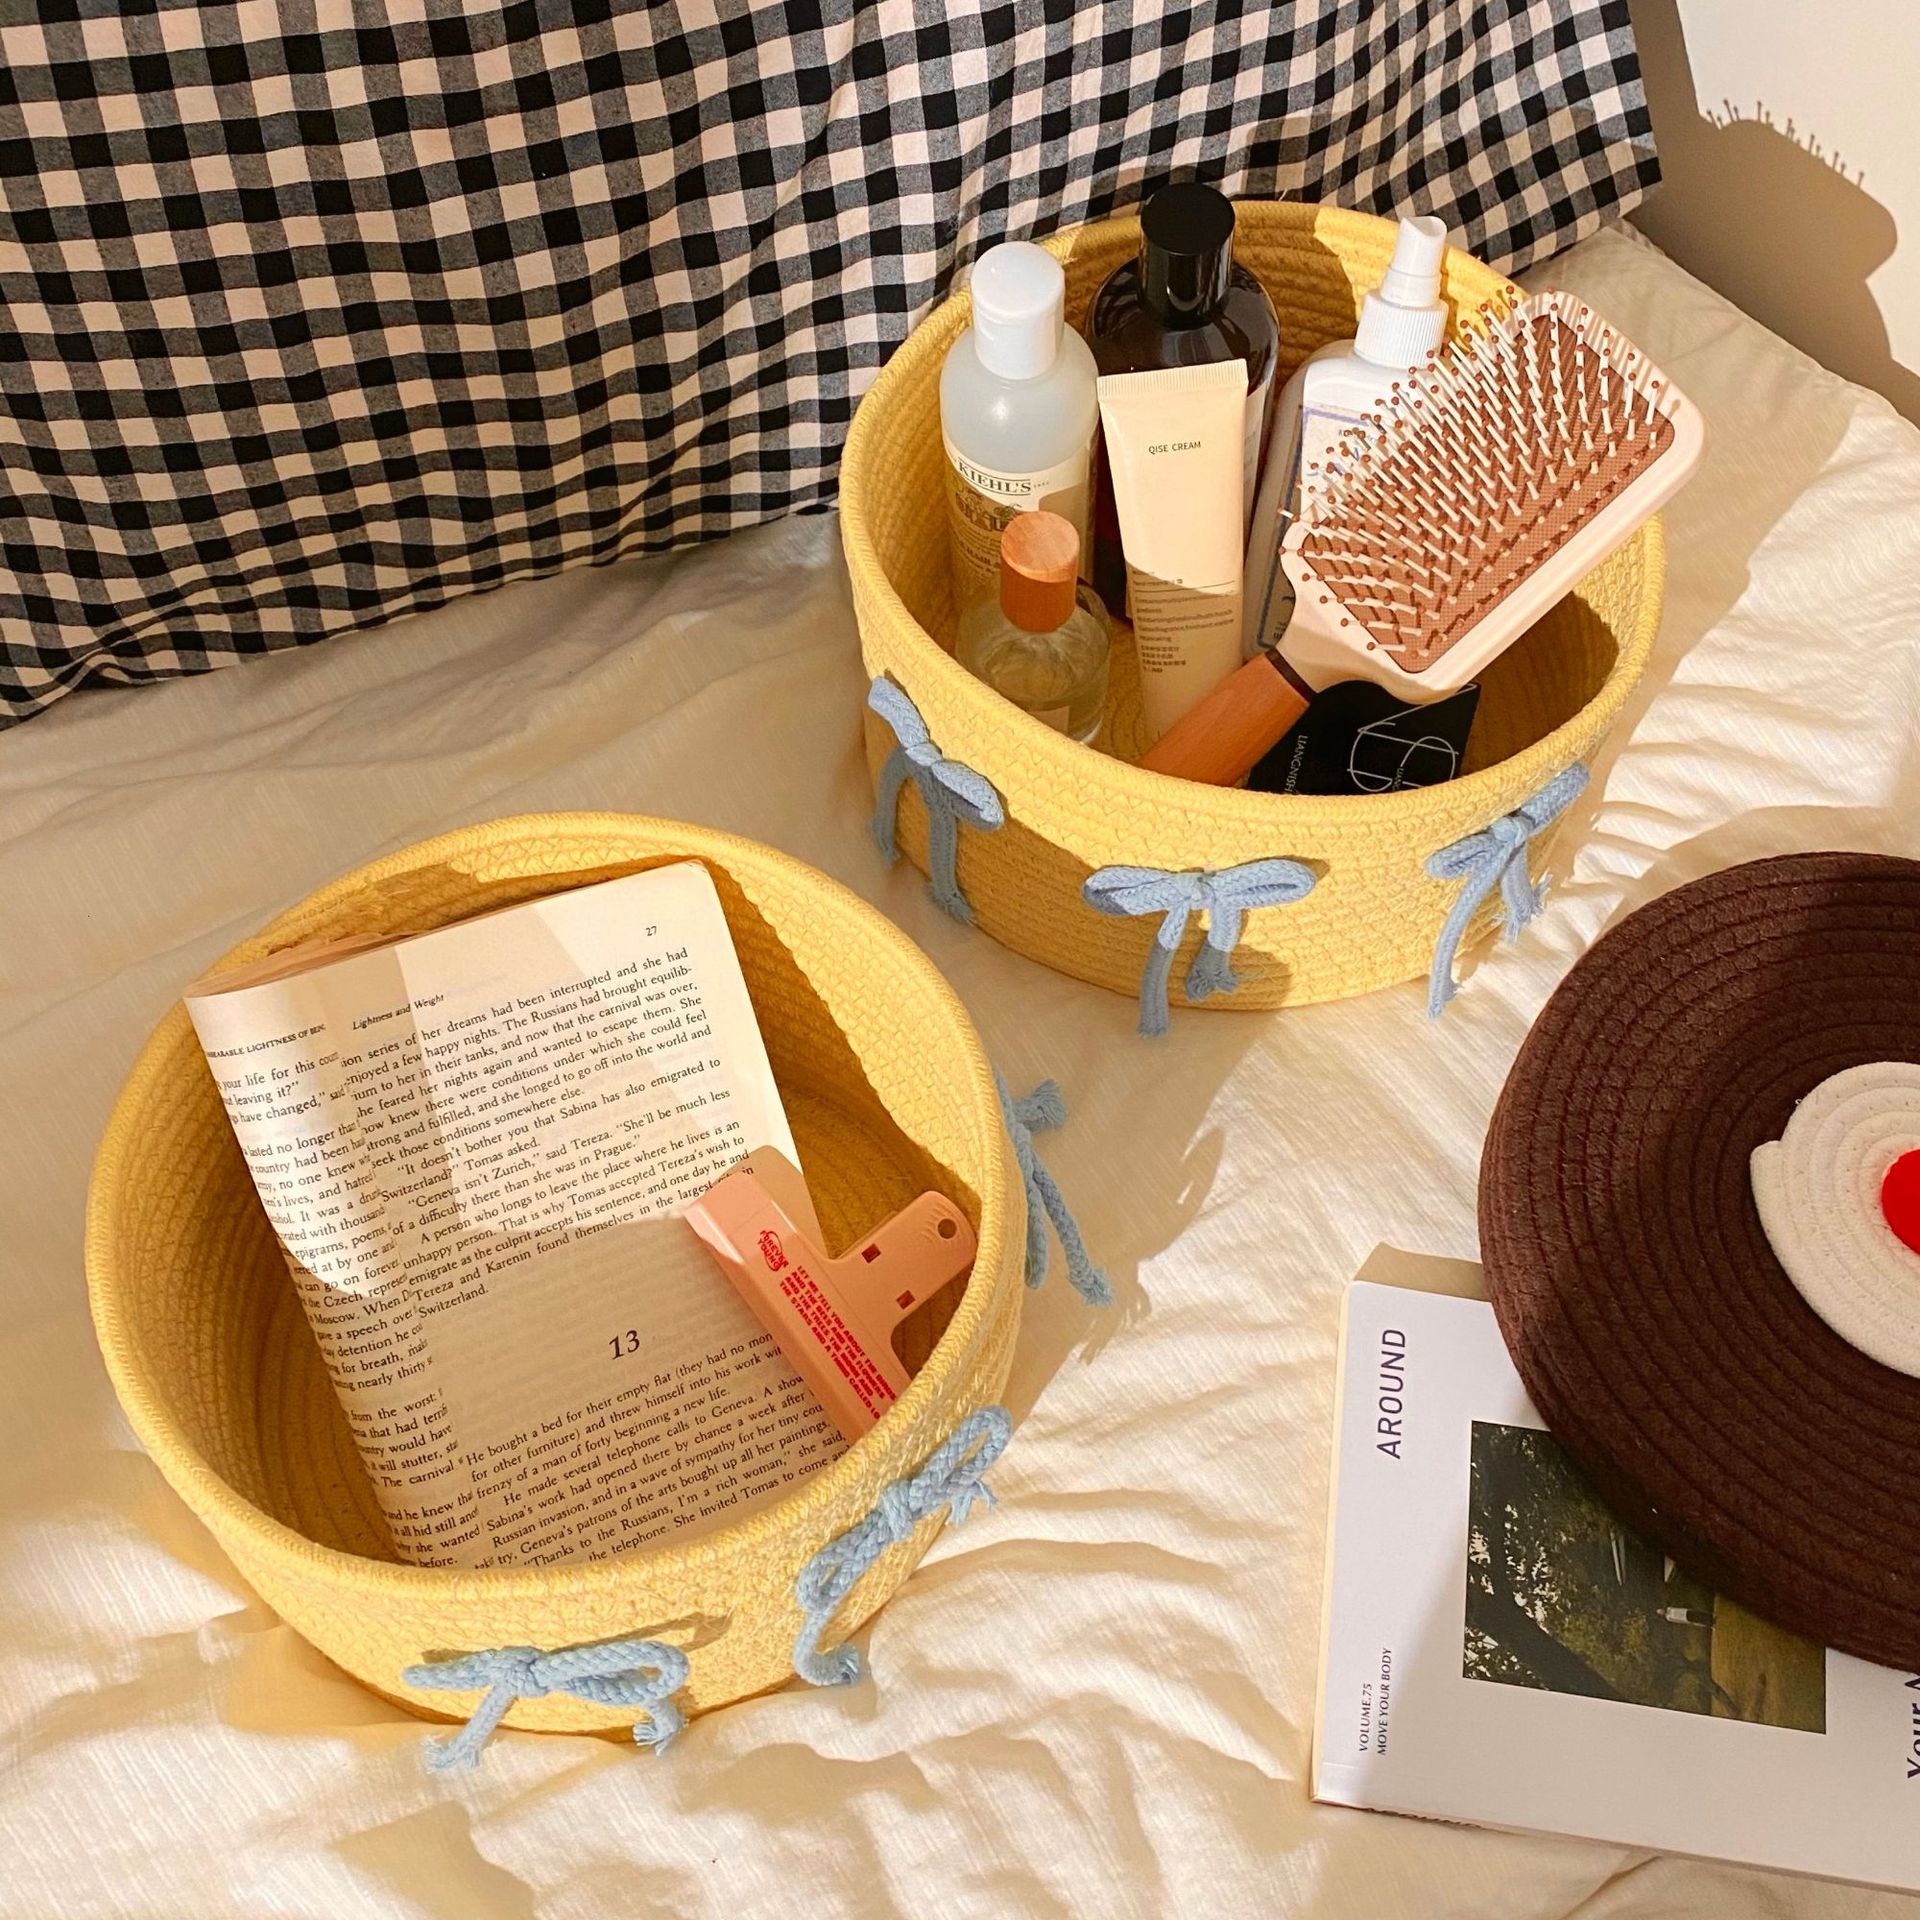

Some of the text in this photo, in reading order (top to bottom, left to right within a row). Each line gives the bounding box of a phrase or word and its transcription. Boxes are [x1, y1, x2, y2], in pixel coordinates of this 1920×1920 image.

[958, 461, 1032, 493] KIEHL'S
[1148, 441, 1201, 455] QISE CREAM
[645, 925, 657, 936] 27
[352, 994, 444, 1030] Lightness and Weight
[367, 1042, 400, 1059] series
[404, 1031, 417, 1046] of
[420, 1028, 440, 1040] her
[446, 1013, 487, 1032] dreams
[490, 1001, 513, 1018] had
[515, 994, 545, 1009] been
[549, 969, 611, 998] interrupted
[616, 961, 638, 977] and
[642, 957, 661, 970] she
[665, 946, 688, 962] had
[380, 1081, 393, 1091] to
[395, 1073, 415, 1086] her
[419, 1068, 432, 1078] in
[434, 1057, 461, 1073] their
[464, 1045, 498, 1062] tanks,
[500, 1034, 522, 1051] and
[524, 1028, 548, 1042] now
[552, 1018, 574, 1033] that
[576, 1012, 595, 1025] the
[598, 994, 641, 1018] carnival
[644, 991, 666, 1002] was
[668, 982, 697, 996] over,
[391, 1060, 399, 1069] a
[401, 1053, 422, 1066] few
[423, 1040, 459, 1058] happy
[462, 1028, 500, 1045] nights.
[501, 1017, 527, 1031] The
[529, 1001, 578, 1023] Russians
[578, 989, 601, 1006] had
[601, 977, 647, 999] brought
[650, 964, 692, 984] equilib-
[244, 1071, 265, 1086] life
[270, 1067, 289, 1081] for
[294, 1059, 315, 1074] this
[378, 1088, 415, 1110] feared
[417, 1083, 438, 1096] her
[443, 1070, 478, 1088] nights
[482, 1058, 512, 1075] again
[516, 1045, 538, 1063] and
[541, 1031, 582, 1053] wanted
[585, 1029, 598, 1039] to
[602, 1016, 638, 1034] escape
[642, 1006, 675, 1020] them.
[679, 996, 701, 1009] She
[232, 1092, 273, 1105] leaving
[238, 1111, 262, 1122] have
[276, 1130, 335, 1154] no longer
[463, 1133, 502, 1153] bother
[507, 1124, 529, 1141] you
[533, 1113, 555, 1128] that
[559, 1100, 597, 1119] Sabina
[600, 1092, 620, 1104] has
[624, 1083, 645, 1096] also
[650, 1060, 704, 1087] emigrated
[708, 1058, 720, 1068] to
[545, 1143, 567, 1160] said
[569, 1131, 613, 1150] Tereza.
[656, 1108, 671, 1120] be
[675, 1094, 707, 1114] much
[709, 1090, 730, 1102] less
[462, 1151, 504, 1171] Tomas
[506, 1135, 540, 1156] asked.
[412, 1280, 454, 1301] Tereza
[459, 1266, 481, 1284] and
[485, 1250, 531, 1274] Karenin
[536, 1231, 570, 1254] found
[574, 1211, 634, 1239] themselves
[638, 1205, 650, 1215] in
[655, 1196, 673, 1208] the
[417, 1282, 488, 1318] Switzerland.
[608, 1329, 640, 1360] 13
[778, 1280, 793, 1296] THE
[790, 1296, 814, 1325] STARS
[810, 1325, 827, 1344] AND
[847, 1377, 873, 1408] CALLED
[784, 1275, 801, 1294] AND
[798, 1294, 812, 1310] THE
[827, 1336, 842, 1352] THE
[857, 1377, 873, 1396] AND
[791, 1270, 807, 1289] AND
[804, 1289, 818, 1304] THE
[830, 1325, 846, 1344] AND
[843, 1344, 857, 1360] THE
[807, 1280, 819, 1293] ME
[829, 1311, 846, 1329] YOU
[842, 1329, 865, 1357] ABOUT
[863, 1357, 877, 1373] THE
[465, 1451, 484, 1466] He
[486, 1432, 528, 1456] bought
[531, 1429, 538, 1438] a
[540, 1415, 563, 1433] bed
[565, 1410, 582, 1423] for
[585, 1397, 611, 1415] their
[615, 1382, 650, 1402] empty
[653, 1372, 671, 1387] flat
[675, 1360, 702, 1378] (they
[705, 1347, 727, 1365] had
[729, 1344, 744, 1355] no
[470, 1469, 487, 1482] for
[492, 1454, 521, 1473] other
[526, 1427, 580, 1459] furniture)
[584, 1415, 606, 1434] and
[609, 1404, 640, 1423] threw
[644, 1382, 685, 1408] himself
[688, 1376, 711, 1390] into
[713, 1368, 731, 1380] his
[733, 1352, 761, 1371] work
[1376, 1329, 1406, 1460] AROUND
[1358, 1683, 1373, 1752] VOLUME.75
[1377, 1648, 1392, 1756] MOVE YOUR BODY
